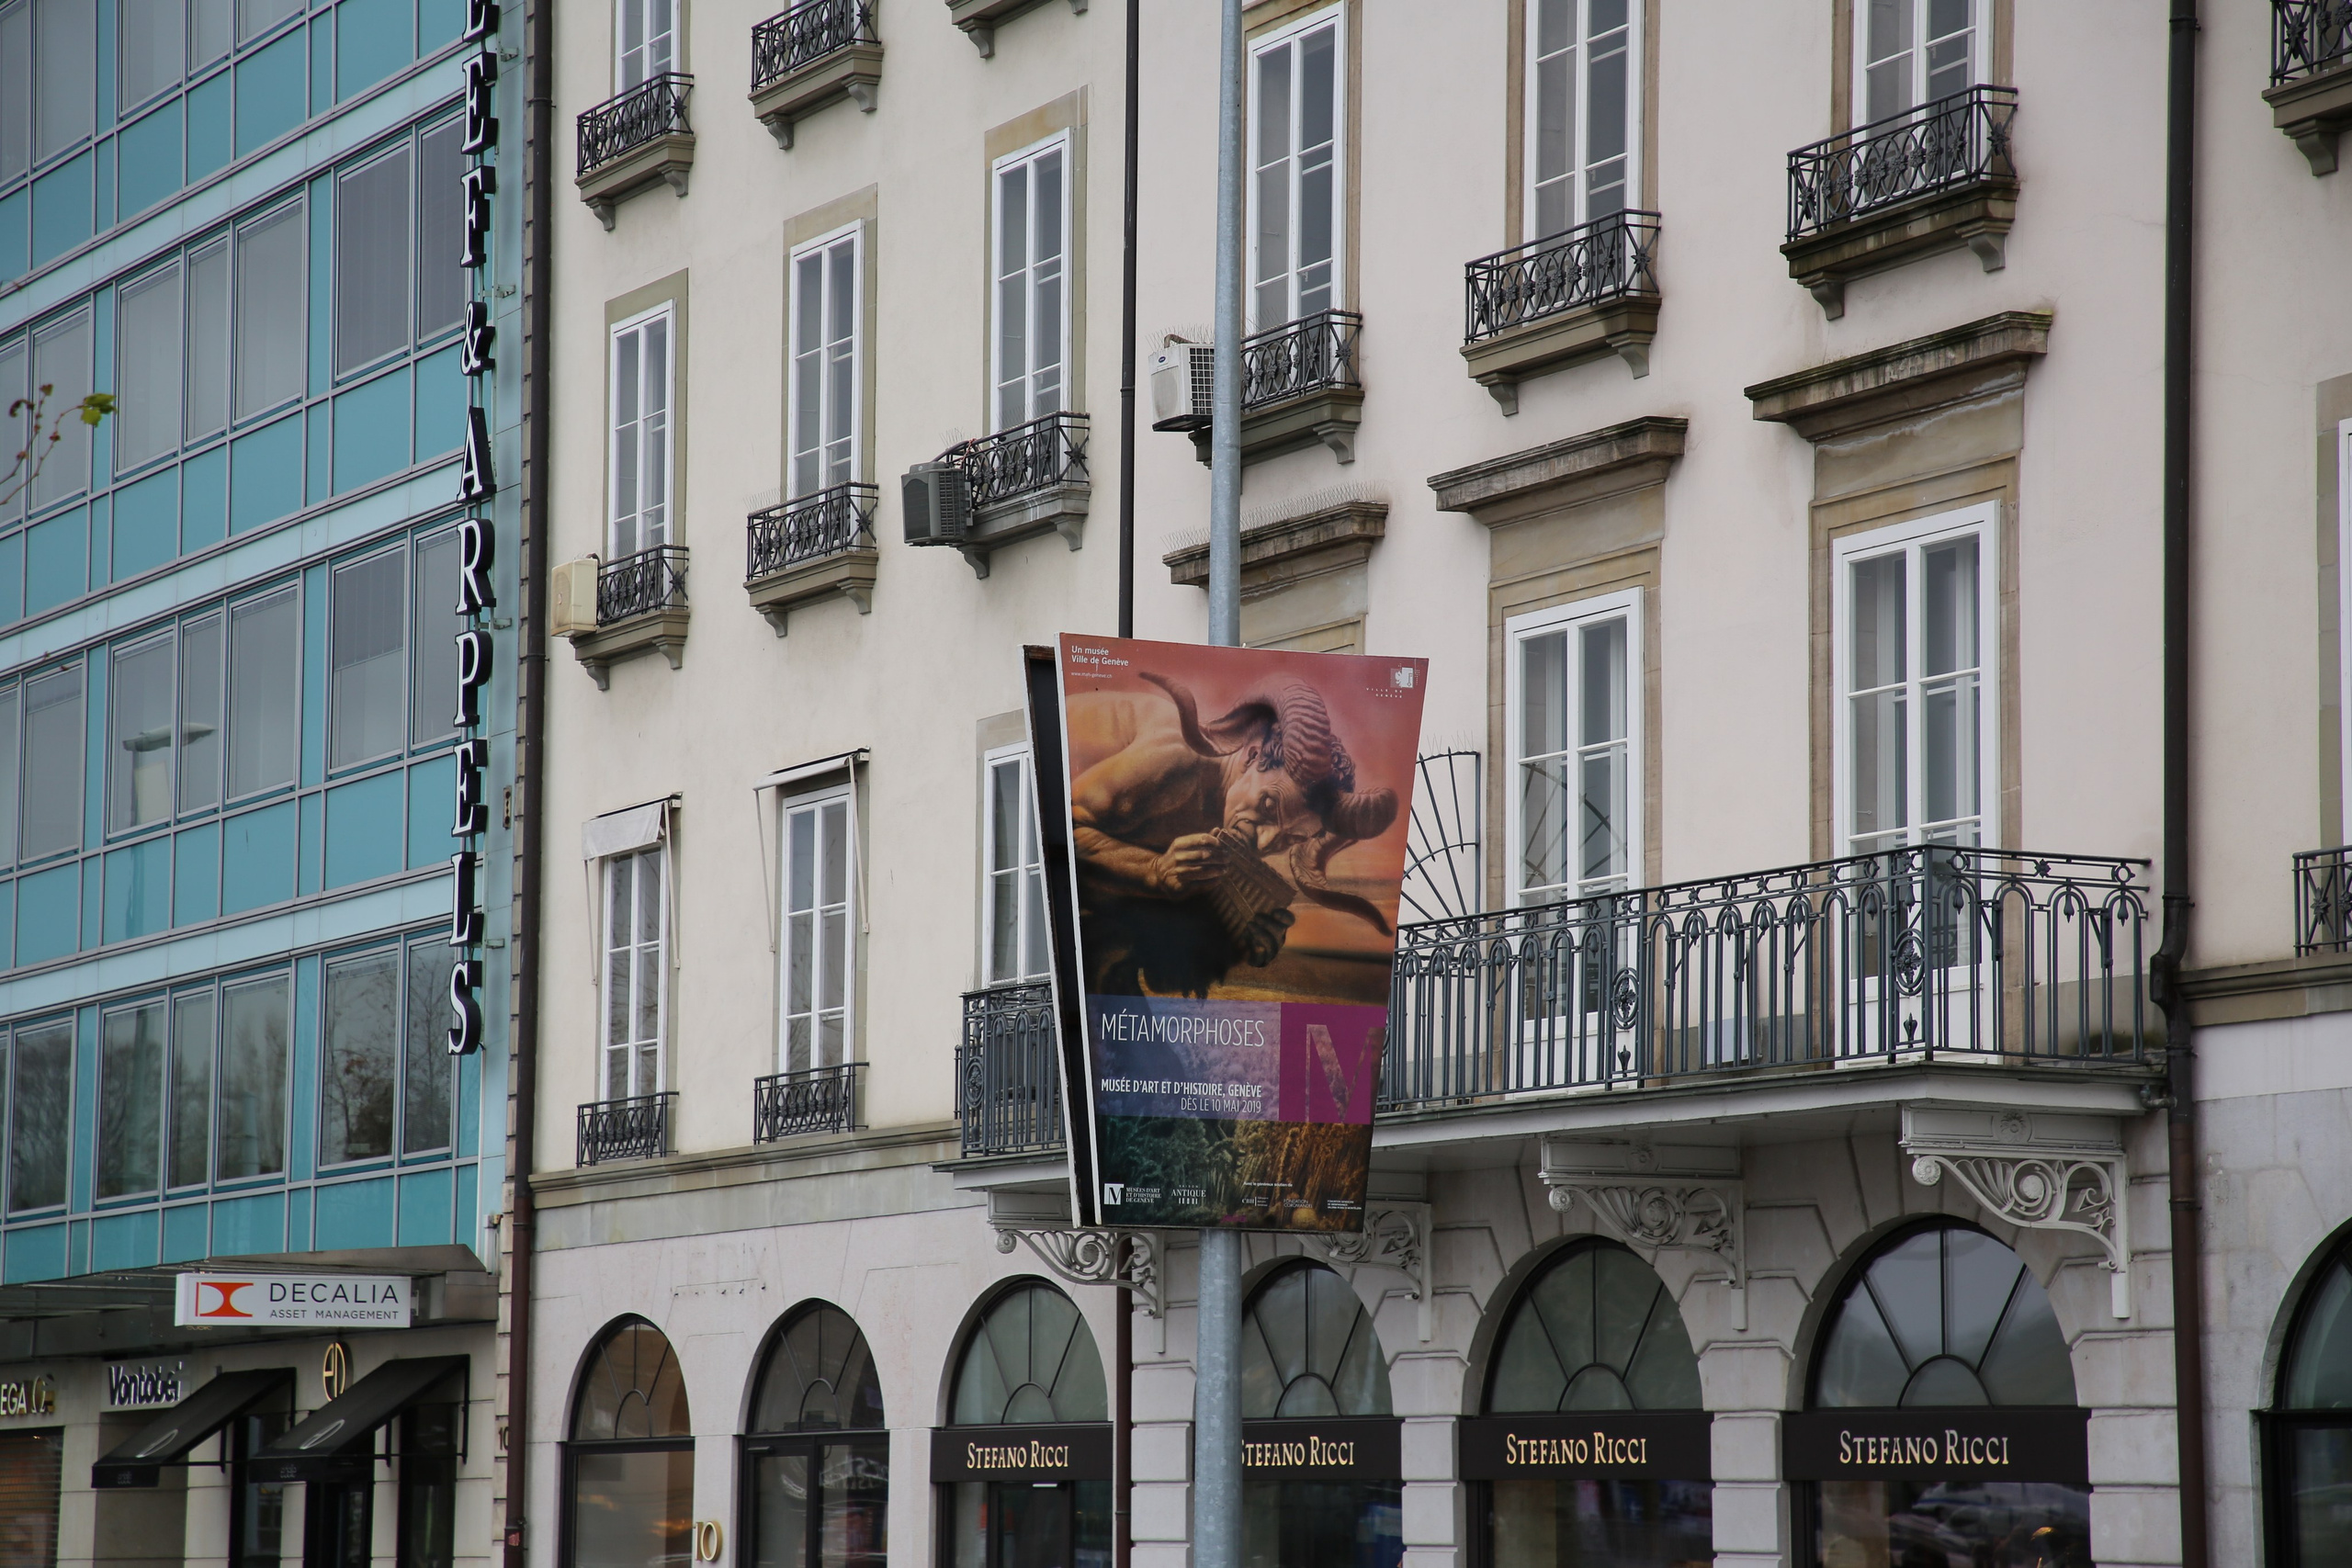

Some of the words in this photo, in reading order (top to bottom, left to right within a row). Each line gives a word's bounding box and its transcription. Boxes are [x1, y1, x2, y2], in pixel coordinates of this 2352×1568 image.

[461, 301, 496, 377] &
[1071, 645, 1082, 654] Un
[1084, 647, 1109, 656] musée
[1071, 654, 1089, 663] Ville
[1090, 656, 1100, 664] de
[1101, 657, 1129, 667] Genève
[447, 407, 496, 1055] ARPELS
[1102, 1008, 1265, 1047] MÉTAMORPHOSES
[1101, 1077, 1131, 1093] MUSÉE
[1133, 1080, 1159, 1094] D'ART
[1161, 1081, 1172, 1094] ET
[1227, 1082, 1262, 1098] GENÈVE
[1181, 1097, 1197, 1111] DÈS
[1199, 1100, 1209, 1111] LE
[1212, 1100, 1221, 1111] 10
[1223, 1100, 1239, 1112] MAI
[1241, 1100, 1261, 1113] 2019
[1170, 1189, 1206, 1197] ANTIQUE
[270, 1282, 399, 1304] DECALIA
[269, 1309, 307, 1319] ASSET
[315, 1310, 399, 1320] MANAGEMENT
[695, 1521, 723, 1562] 10
